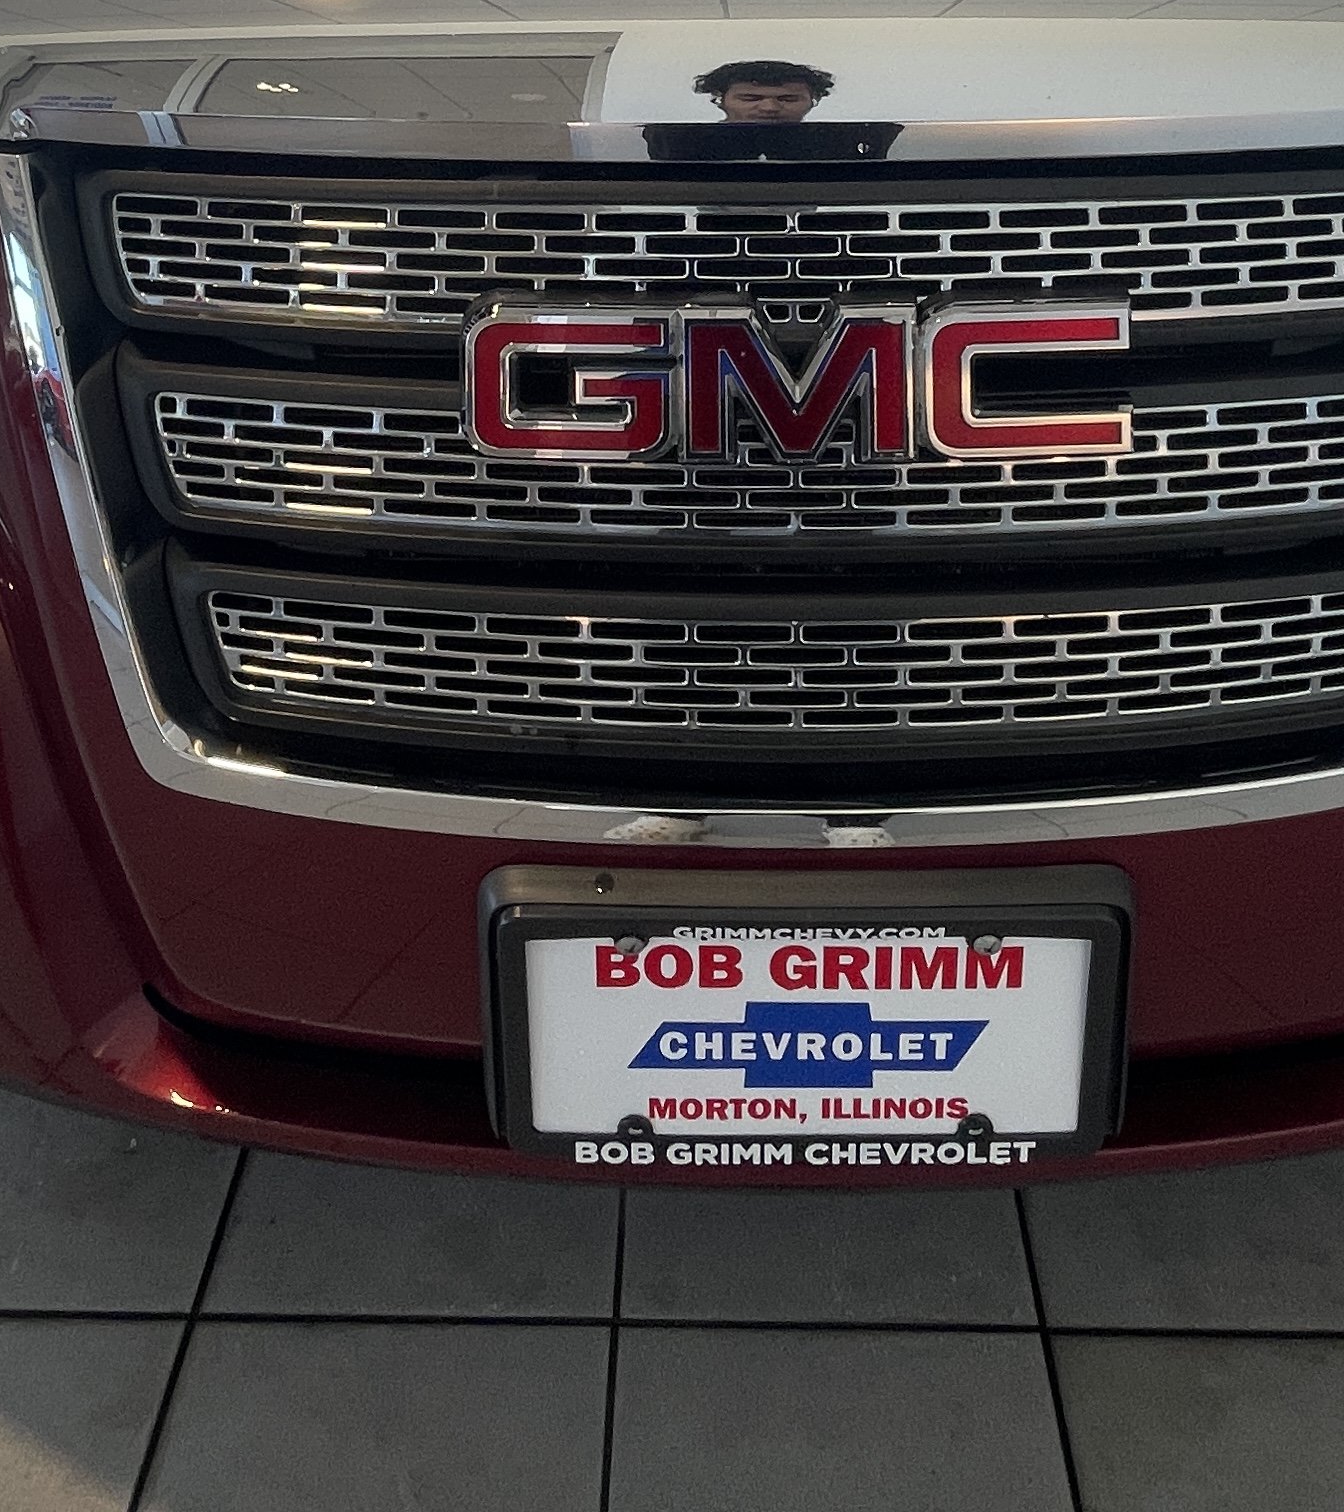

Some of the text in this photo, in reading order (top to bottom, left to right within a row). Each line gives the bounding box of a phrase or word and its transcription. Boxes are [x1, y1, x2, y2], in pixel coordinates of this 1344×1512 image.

[463, 303, 1134, 463] GMC
[672, 926, 946, 940] GRIMMCHEVY.COM
[595, 945, 1024, 991] BOB GRIMM
[659, 1031, 954, 1061] CHEVROLET
[648, 1097, 969, 1123] MORTON, ILLINOIS
[574, 1141, 1036, 1165] BOB GRIMM CHEVROLET
